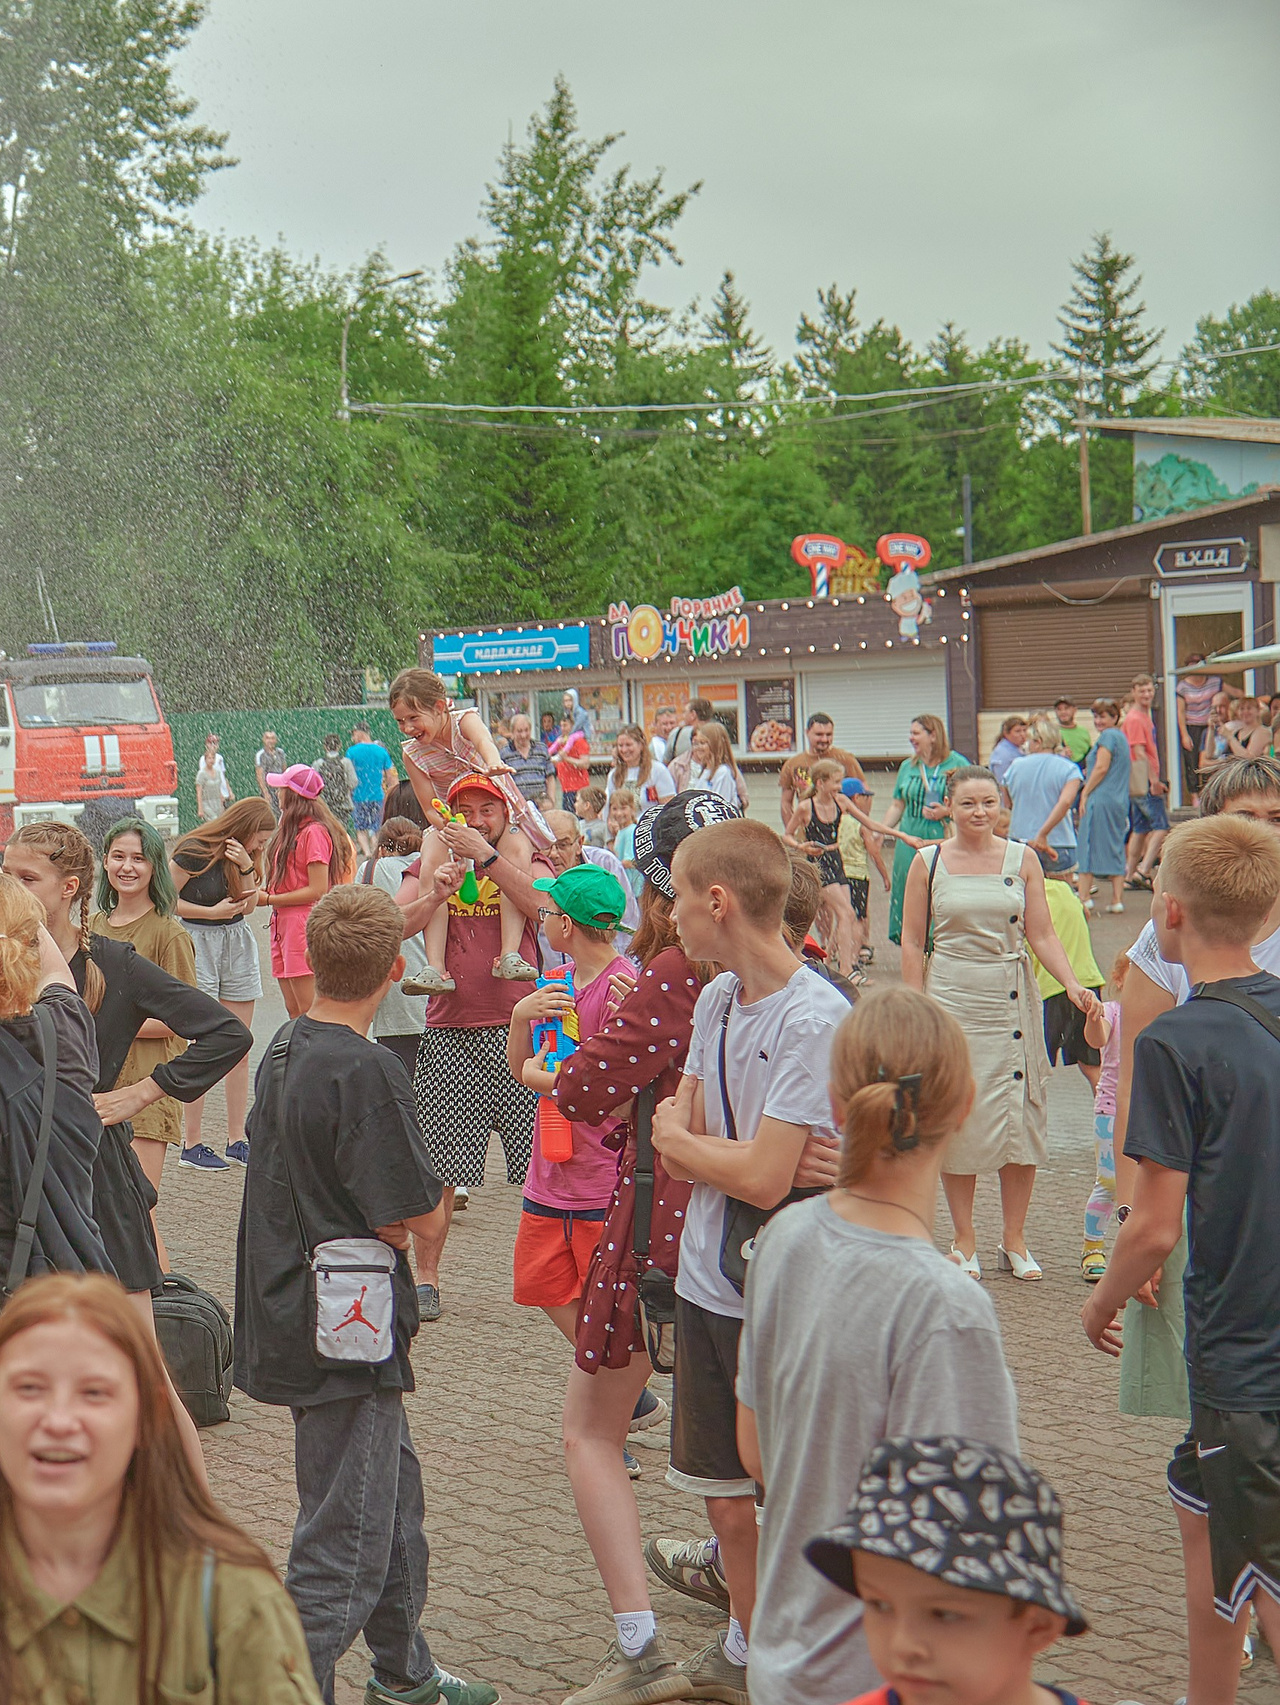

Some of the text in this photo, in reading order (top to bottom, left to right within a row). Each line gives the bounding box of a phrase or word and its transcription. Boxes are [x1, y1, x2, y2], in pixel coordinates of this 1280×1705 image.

[1175, 547, 1230, 567] ВХОД
[671, 586, 744, 619] ГОРЯЧИЕ
[612, 604, 751, 660] ПОНЧИКИ
[474, 645, 543, 660] МОРОЖЕНОЕ
[335, 1335, 379, 1345] AIR
